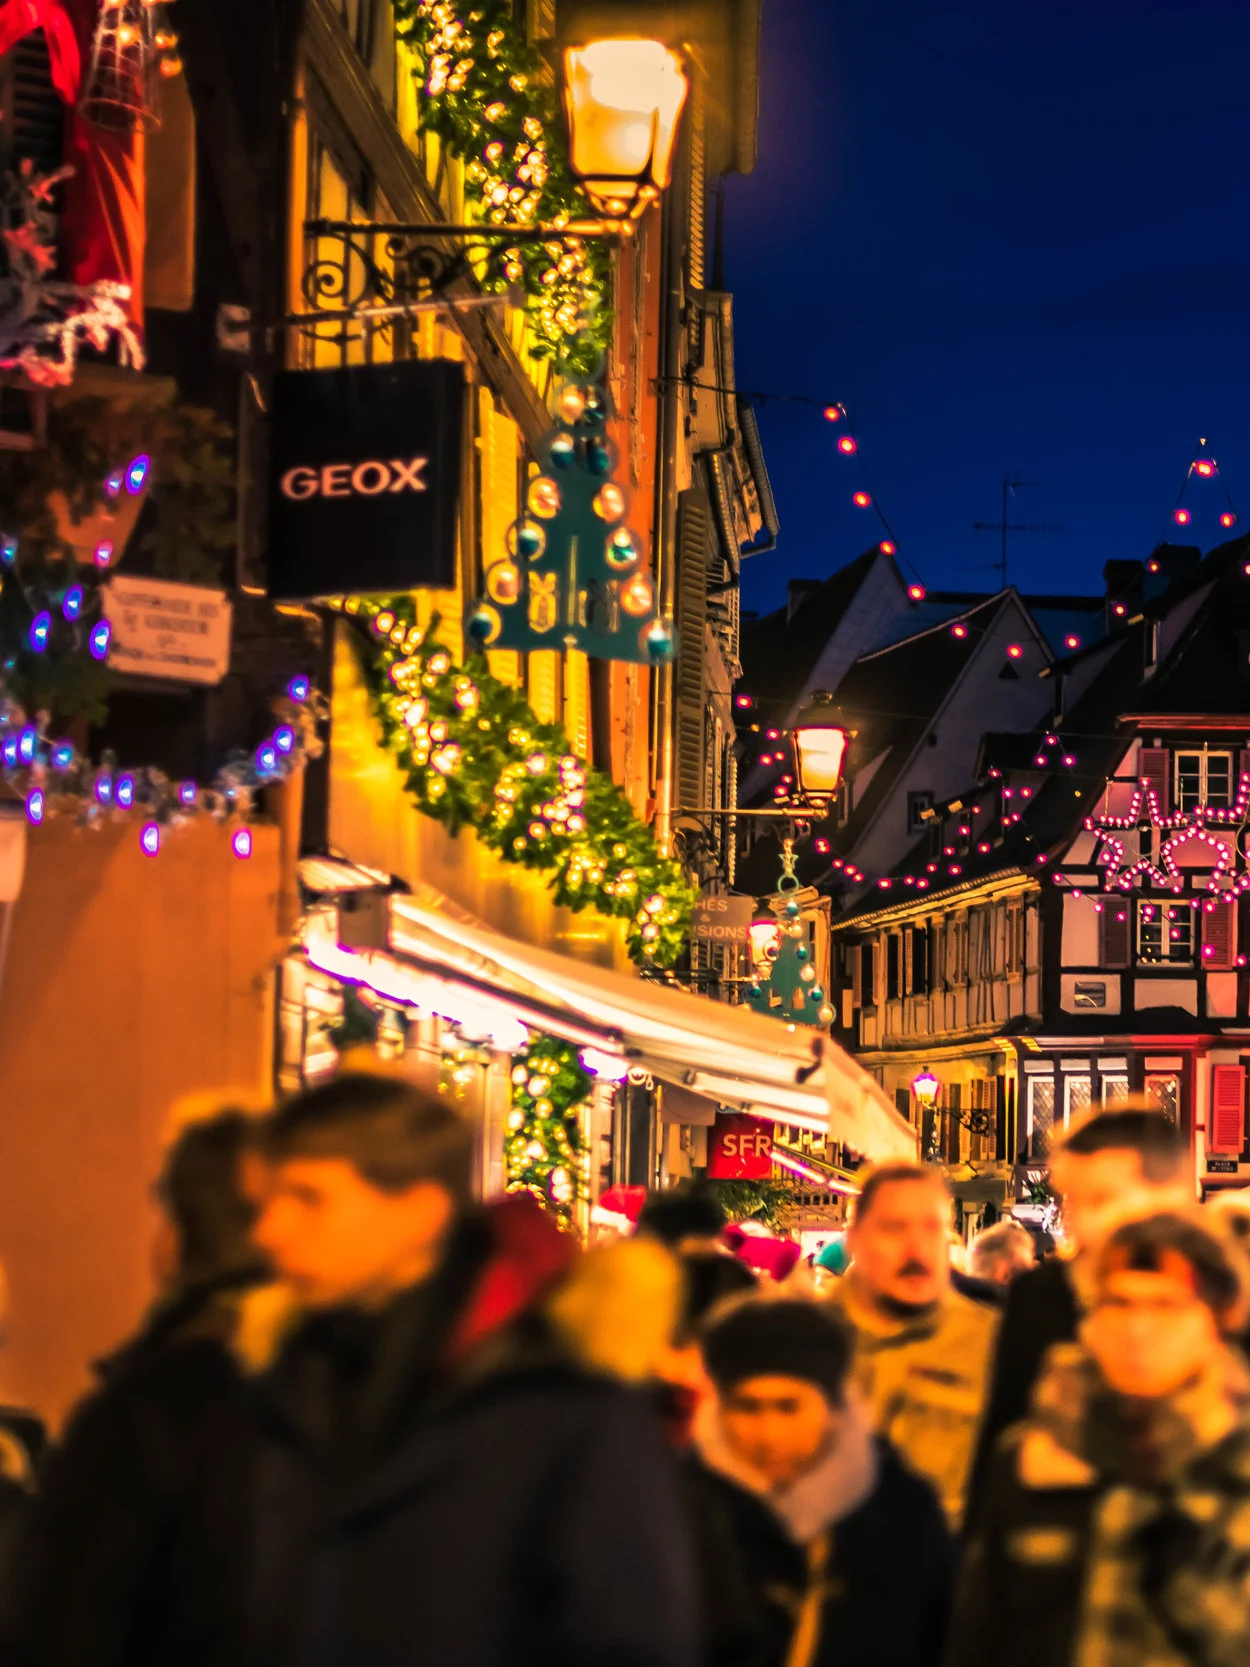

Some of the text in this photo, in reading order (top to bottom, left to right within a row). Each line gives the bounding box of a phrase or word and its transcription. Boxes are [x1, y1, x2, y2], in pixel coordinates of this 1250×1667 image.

[281, 457, 428, 500] GEOX
[693, 925, 746, 938] SIONS
[723, 1134, 772, 1157] SFR
